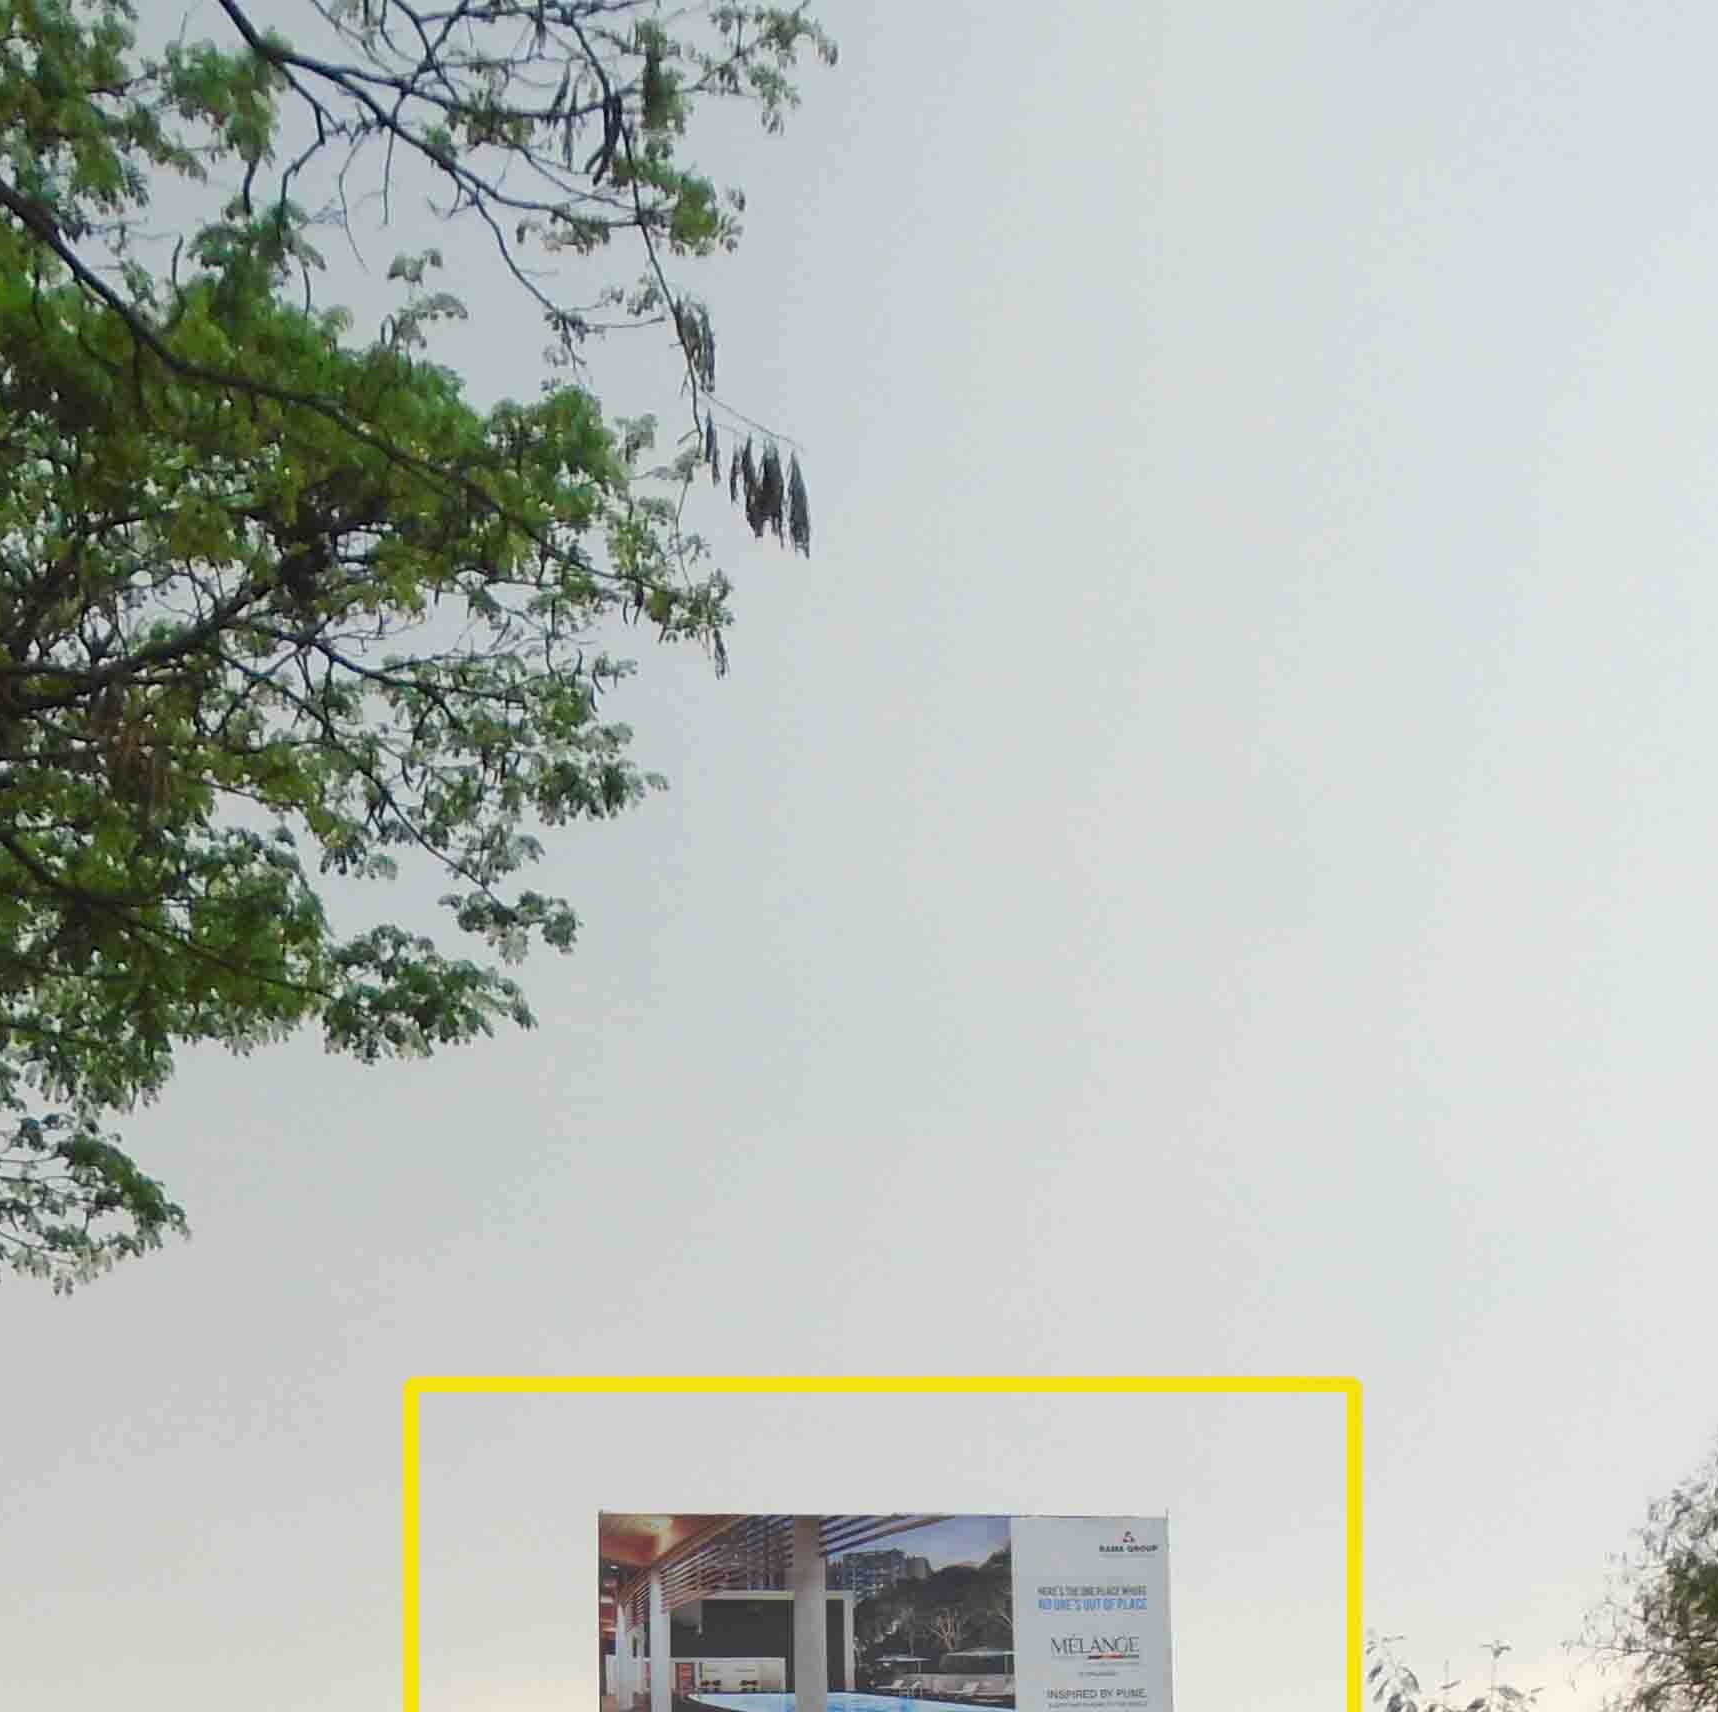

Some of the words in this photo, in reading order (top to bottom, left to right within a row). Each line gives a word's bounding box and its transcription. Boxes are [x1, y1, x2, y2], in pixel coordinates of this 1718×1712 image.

[1127, 1544, 1159, 1553] GROUP
[1046, 1688, 1098, 1700] INSPIRED
[1099, 1688, 1114, 1699] BY
